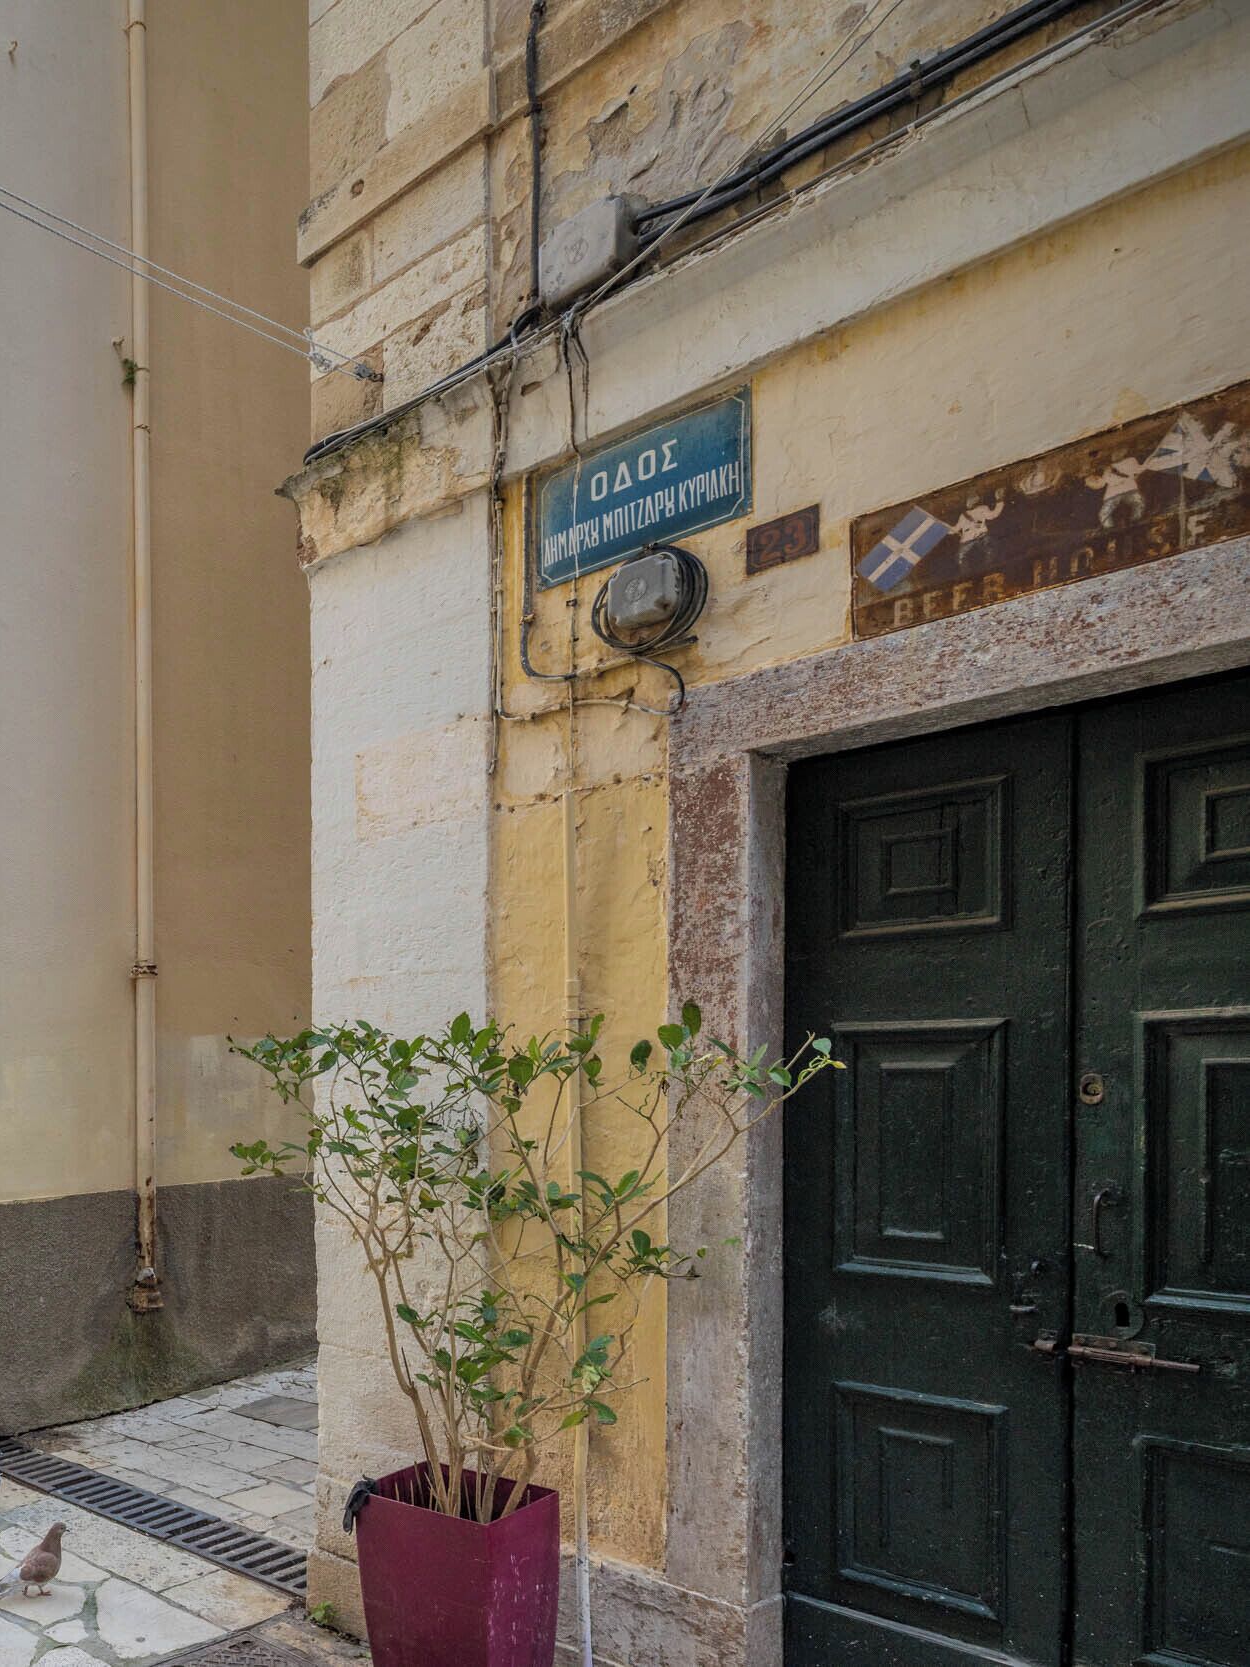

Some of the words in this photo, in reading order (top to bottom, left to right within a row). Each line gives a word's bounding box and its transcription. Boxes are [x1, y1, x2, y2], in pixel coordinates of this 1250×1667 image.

[590, 439, 679, 502] ΟΔΟΣ
[678, 460, 741, 513] ΚΥΡΙΑΚΗ
[759, 517, 807, 562] 23
